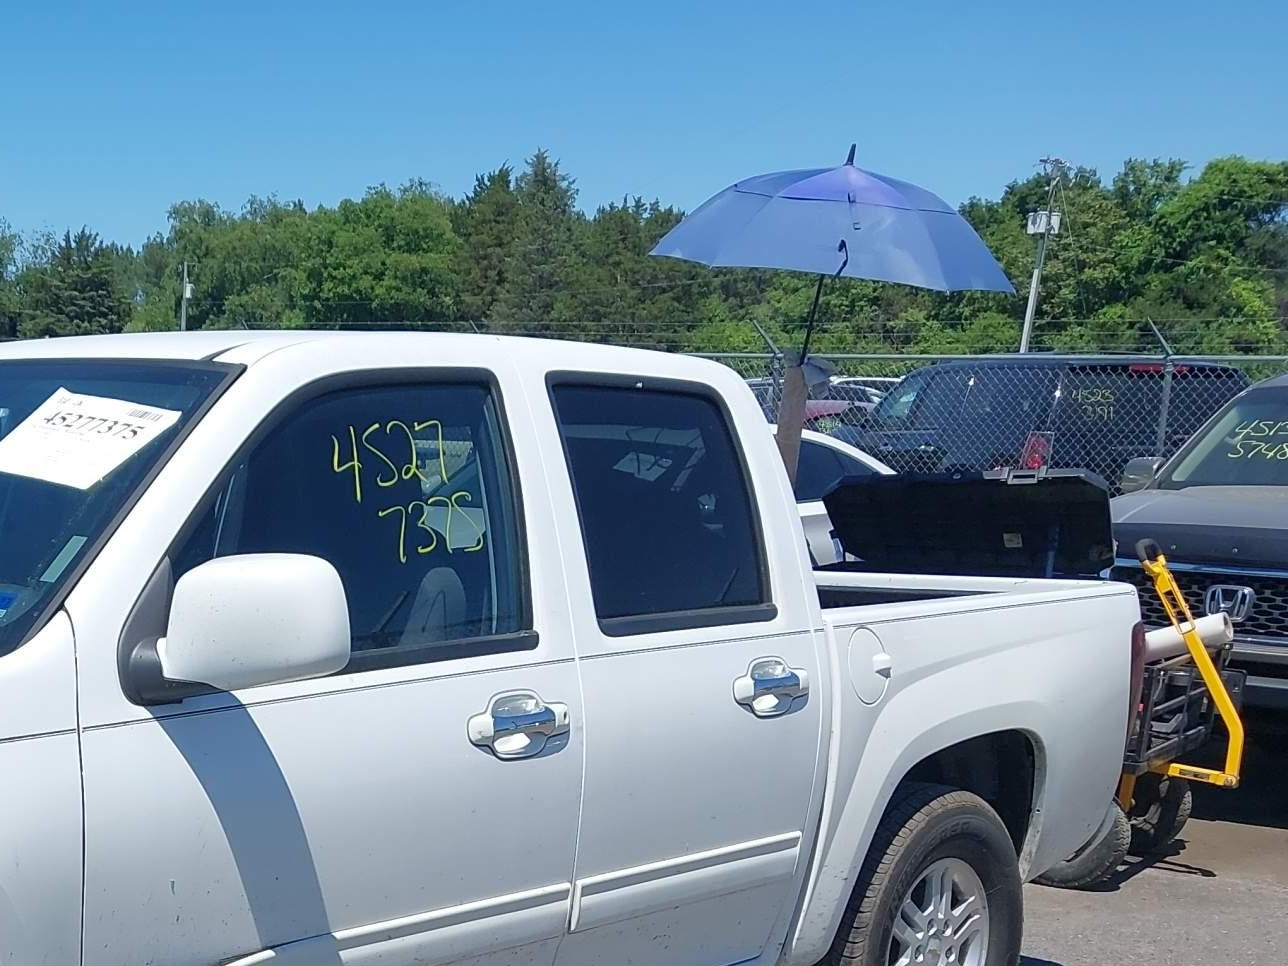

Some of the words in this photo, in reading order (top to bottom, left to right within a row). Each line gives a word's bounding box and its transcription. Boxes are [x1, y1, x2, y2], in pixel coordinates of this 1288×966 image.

[1071, 387, 1114, 403] 4523
[43, 411, 145, 440] 45277375
[331, 420, 449, 503] 4527
[1227, 440, 1288, 460] 5748
[378, 491, 484, 563] 7375
